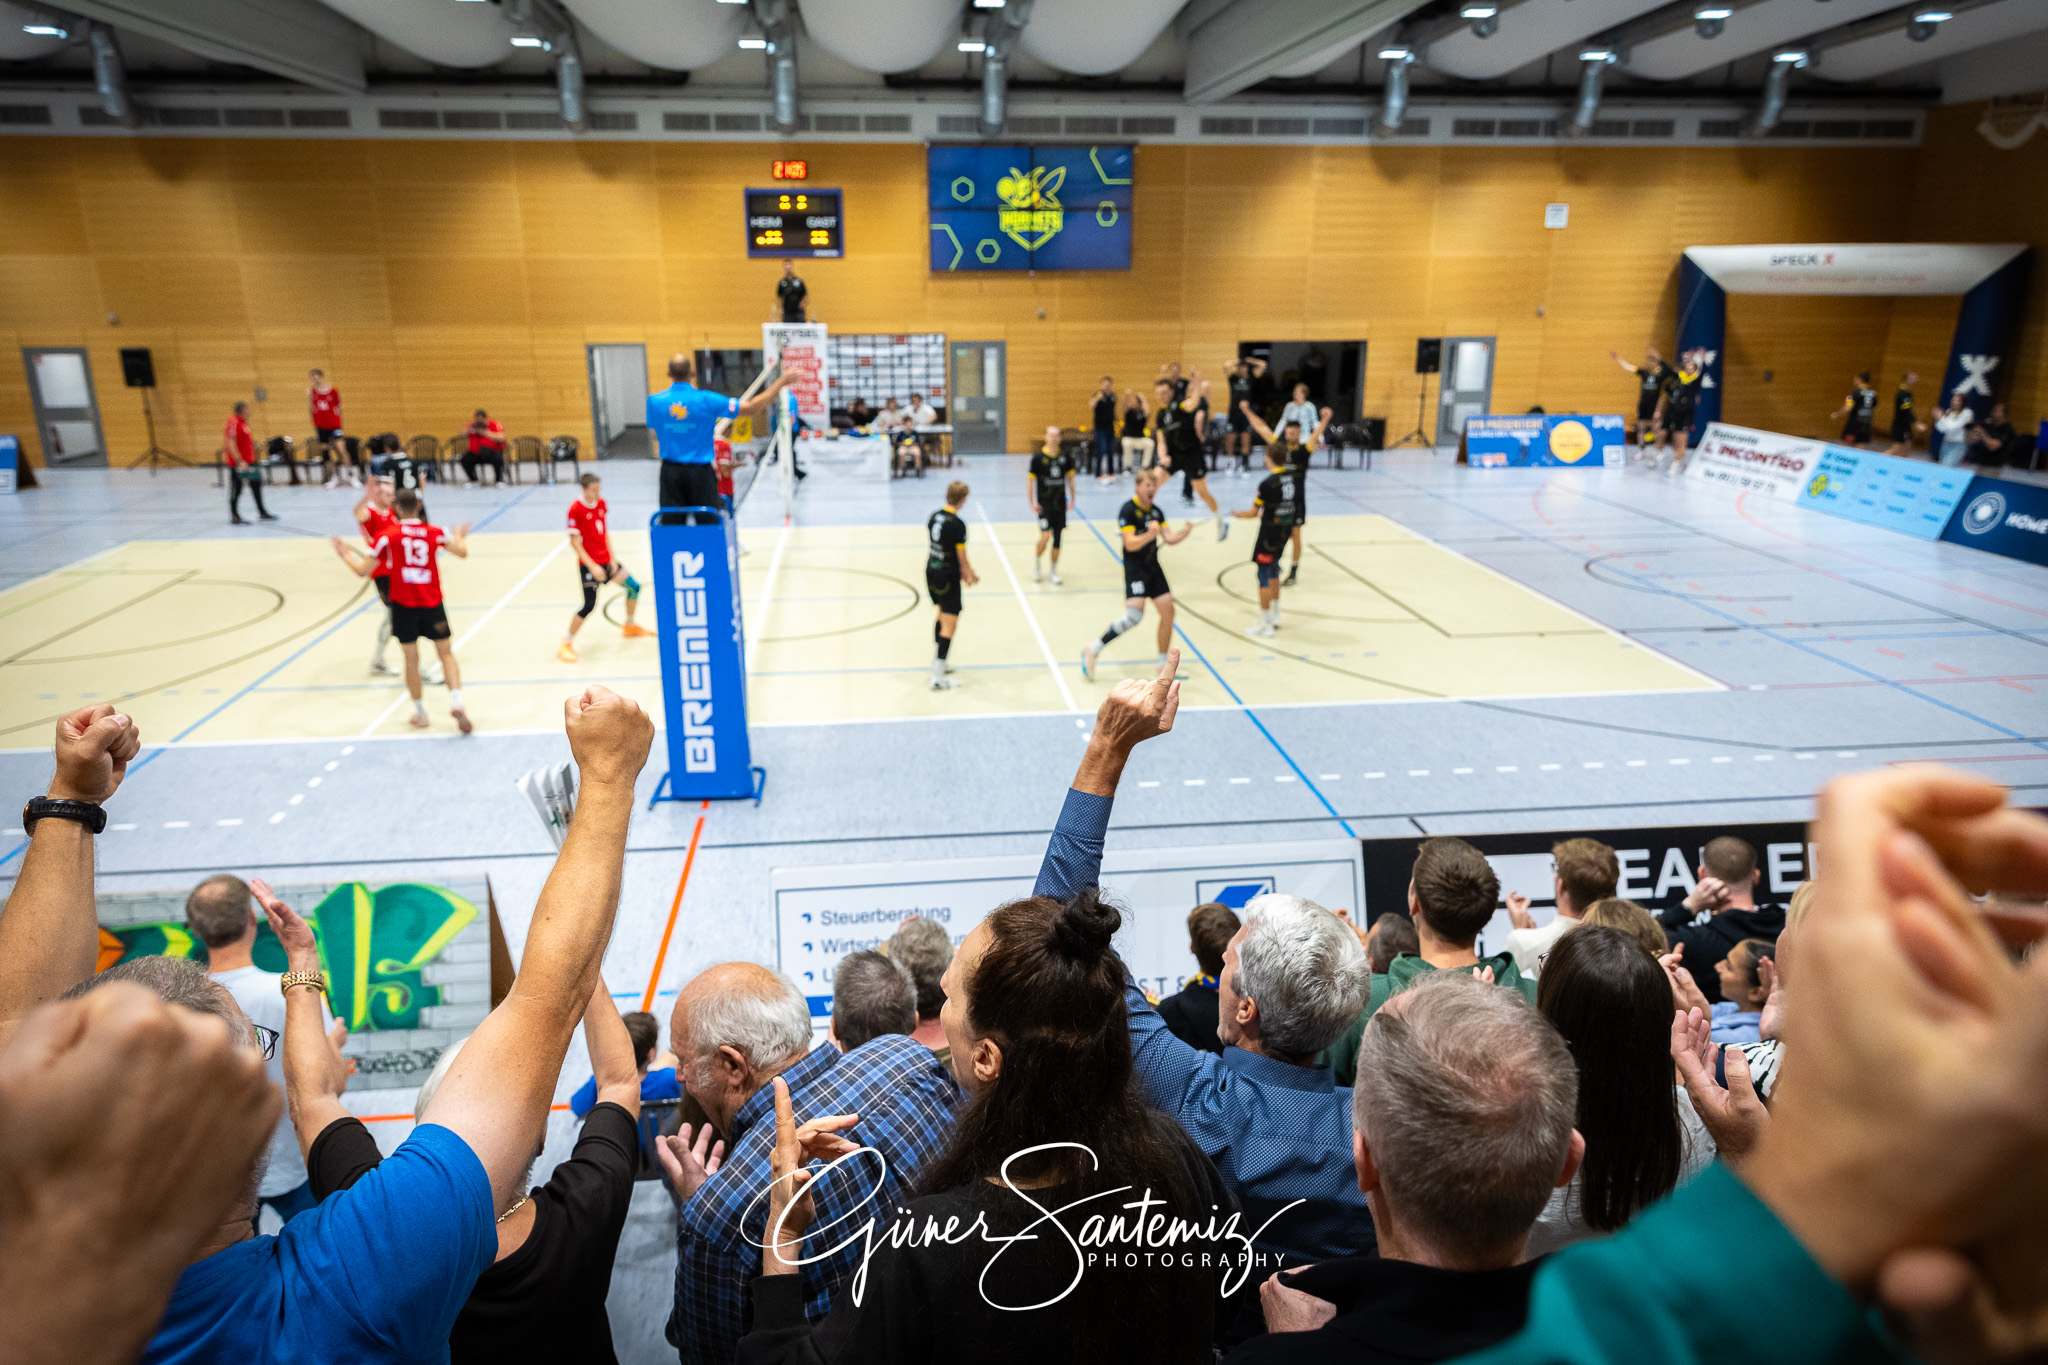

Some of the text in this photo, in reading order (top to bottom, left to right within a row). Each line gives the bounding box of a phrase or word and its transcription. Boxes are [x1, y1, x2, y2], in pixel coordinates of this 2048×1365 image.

[401, 536, 429, 567] 13
[672, 550, 717, 773] BREMER
[820, 906, 951, 925] Steuerberatung
